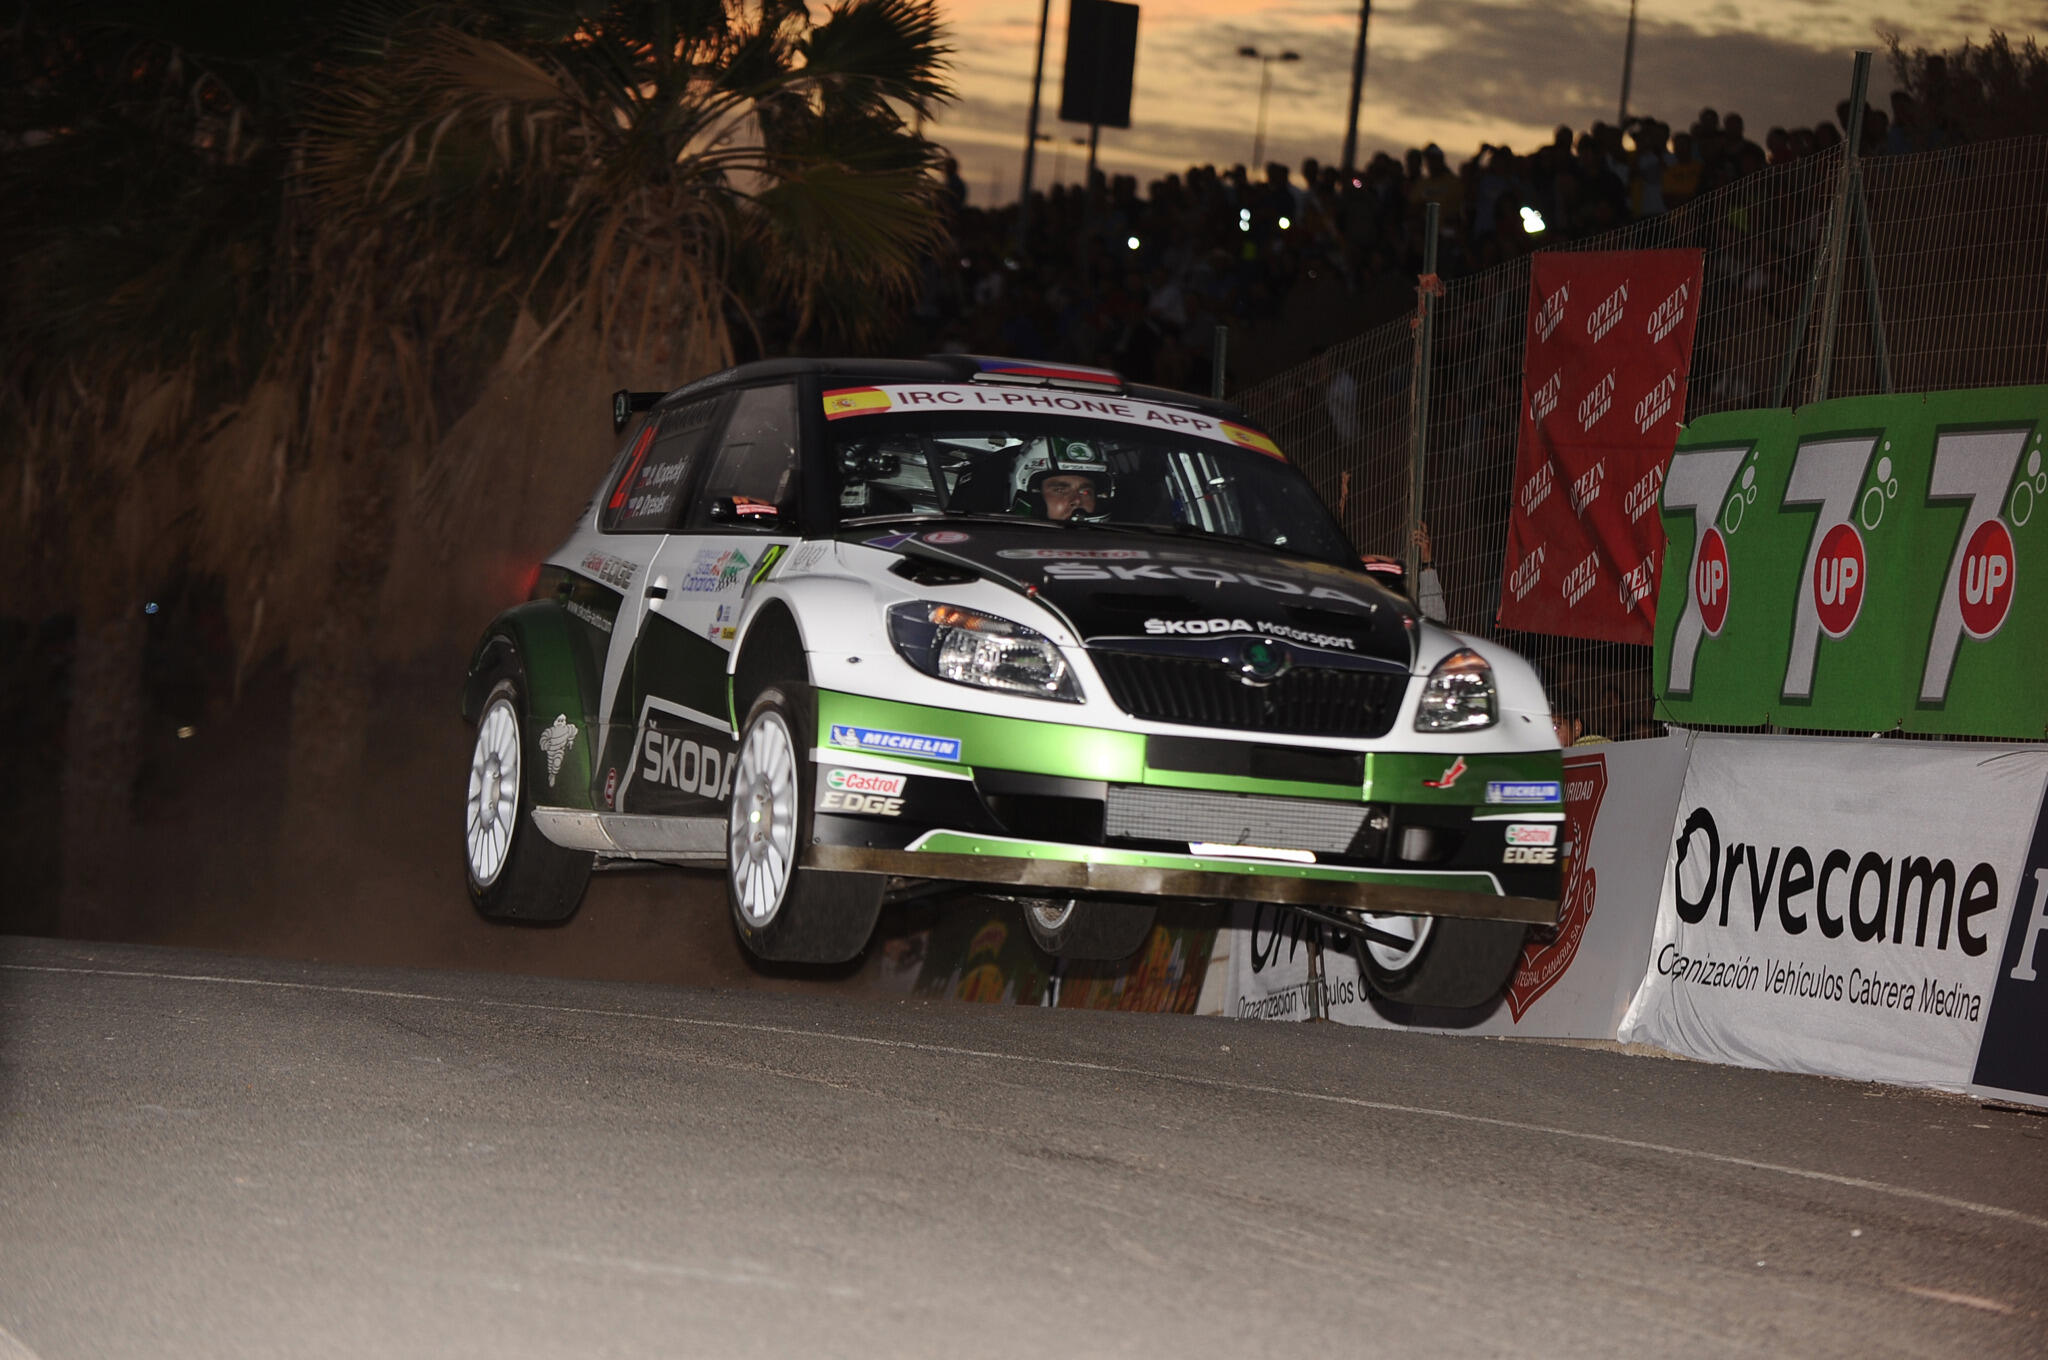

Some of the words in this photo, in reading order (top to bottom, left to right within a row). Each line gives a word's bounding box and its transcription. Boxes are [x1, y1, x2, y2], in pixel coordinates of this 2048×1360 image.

[1535, 280, 1570, 336] OPEIN
[1587, 279, 1629, 335] OPEIN
[1647, 278, 1690, 335] OPEIN
[896, 390, 965, 406] IRC
[976, 392, 1136, 419] I-PHONE
[1145, 410, 1213, 431] APP
[1578, 368, 1617, 423] OPEIN
[1634, 368, 1677, 425] OPEIN
[1624, 460, 1665, 515] OPEIN
[1043, 562, 1378, 610] ŠKODA
[1509, 541, 1547, 593] OPEIN
[1700, 559, 1725, 606] UP
[1820, 556, 1859, 606] UP
[1966, 554, 2008, 605] UP
[1144, 618, 1254, 635] ŠKODA
[1256, 620, 1356, 651] Motorsport
[643, 717, 738, 802] ŠKODA
[861, 732, 955, 756] MICHELIN
[820, 791, 906, 817] EDGE
[844, 773, 900, 795] Castrol
[1564, 780, 1595, 802] URIDAD
[1502, 847, 1557, 864] EDGE
[1675, 807, 1999, 957] Orvecame
[1513, 970, 1541, 988] TEGRAL
[1541, 941, 1572, 981] CANARIA
[1764, 957, 1844, 1000] Vehículos
[1848, 967, 1915, 1012] Cabrera
[1918, 977, 1982, 1023] Medina
